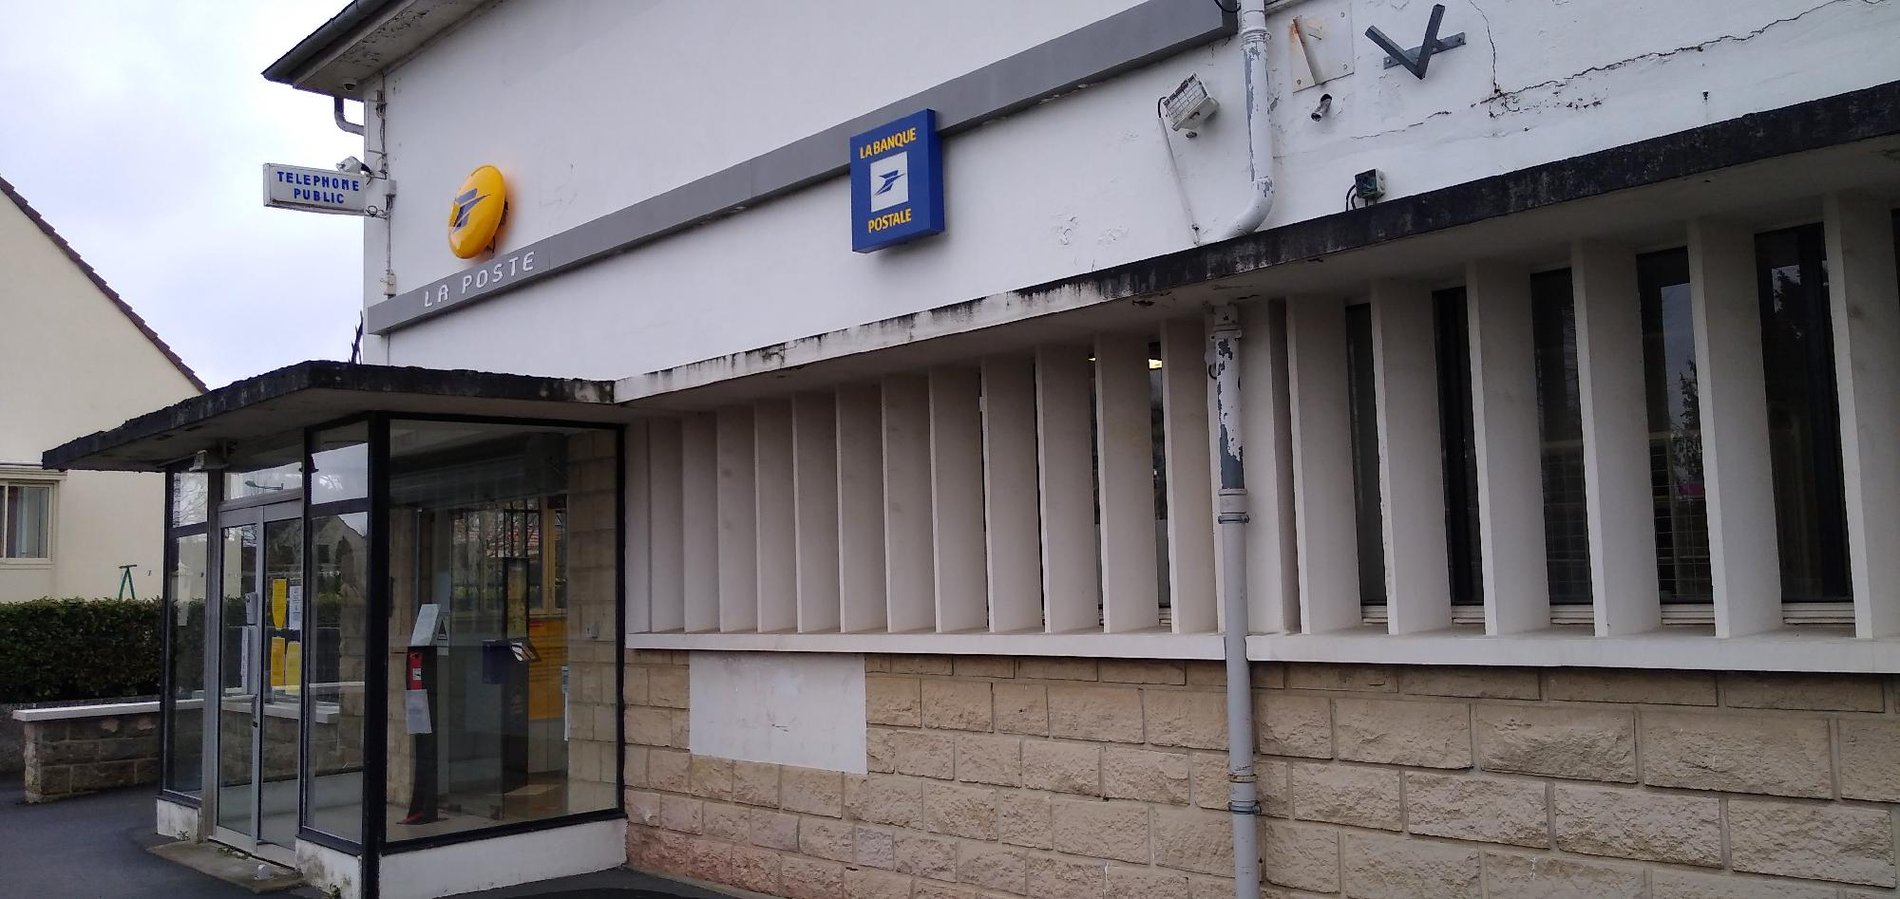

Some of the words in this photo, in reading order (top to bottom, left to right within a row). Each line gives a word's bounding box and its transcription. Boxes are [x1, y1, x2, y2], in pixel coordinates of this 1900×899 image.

[860, 144, 873, 159] LA
[873, 127, 917, 155] BANQUE
[277, 171, 360, 192] TELEPHONE
[293, 188, 345, 204] PUBLIC
[868, 208, 912, 233] POSTALE
[424, 284, 449, 307] LA
[461, 251, 535, 294] POSTE
